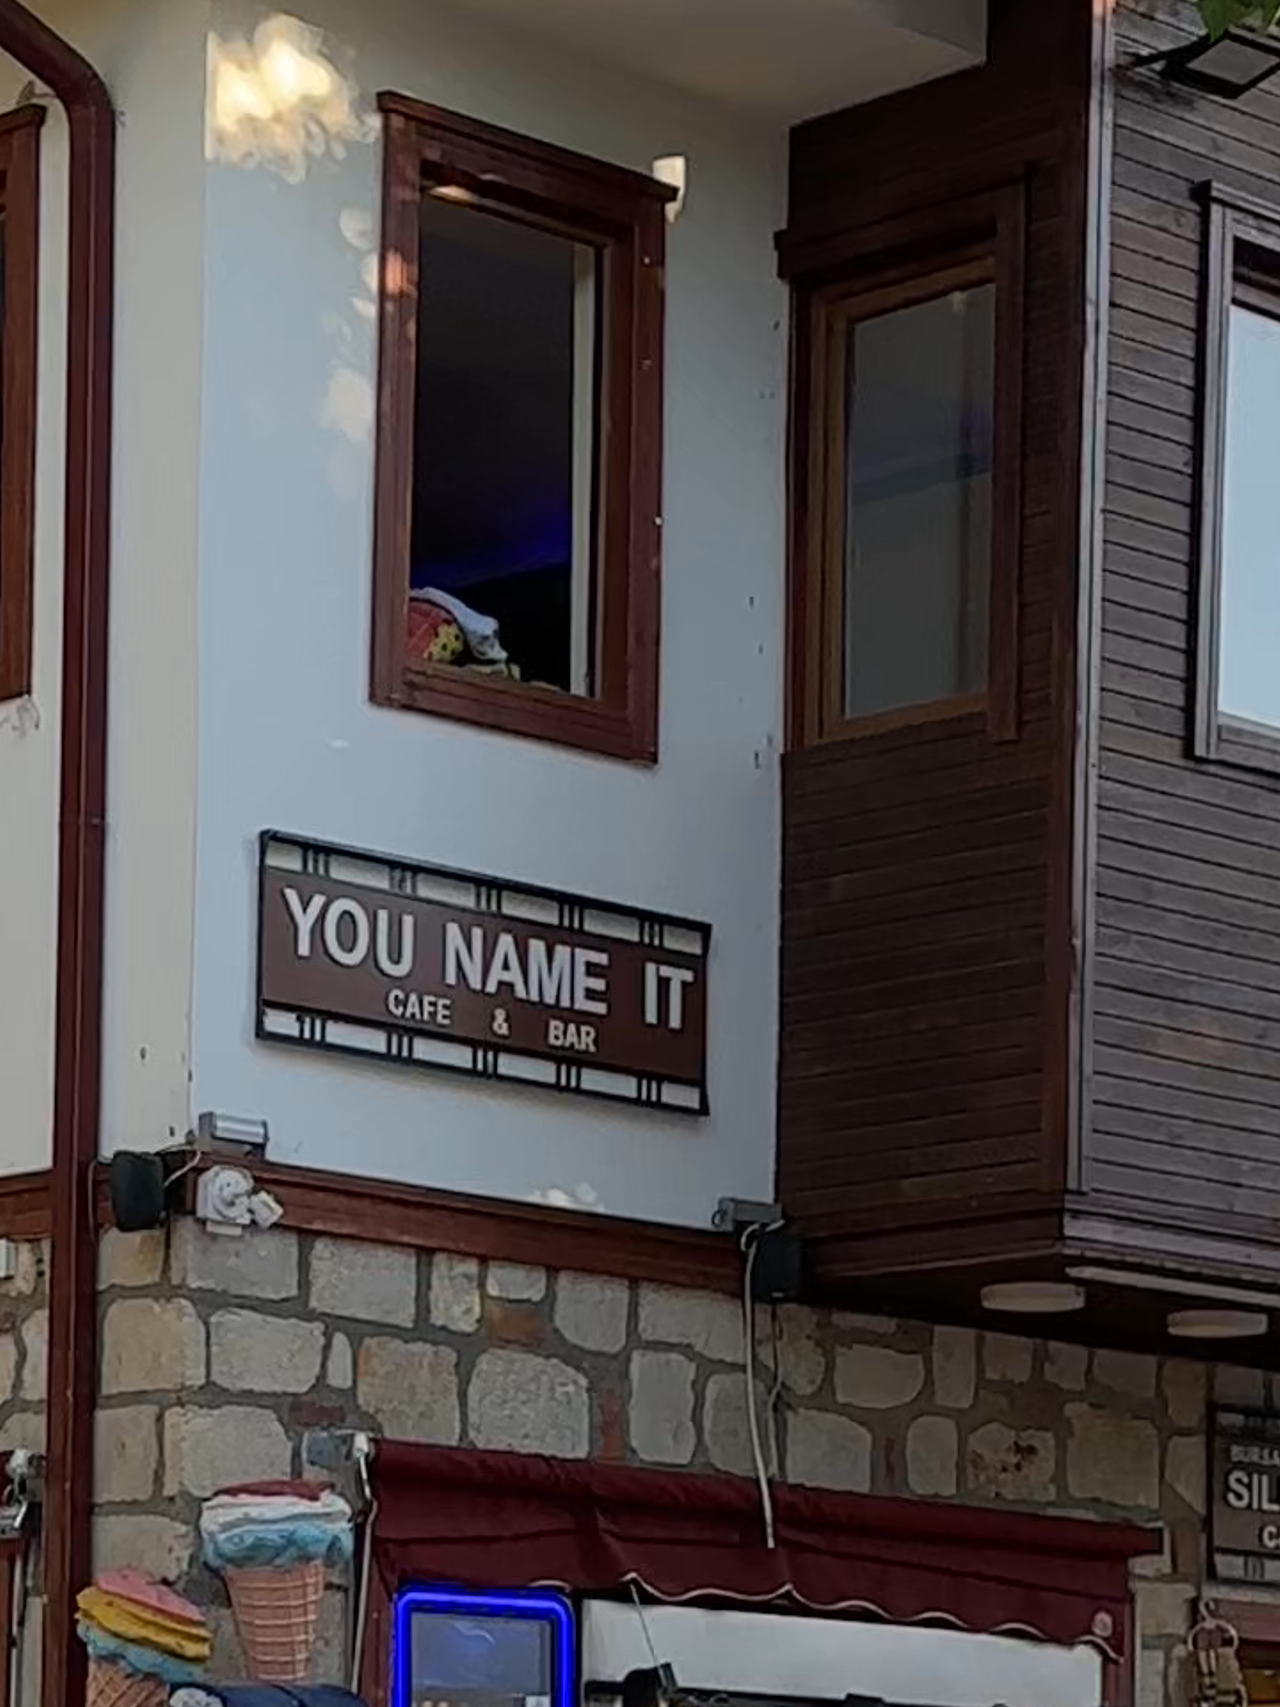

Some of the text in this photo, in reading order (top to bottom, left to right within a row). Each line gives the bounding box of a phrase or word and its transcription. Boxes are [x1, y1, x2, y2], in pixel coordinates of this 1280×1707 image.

[283, 887, 694, 1029] YOU NAME IT
[388, 988, 596, 1052] CAFE & BAR
